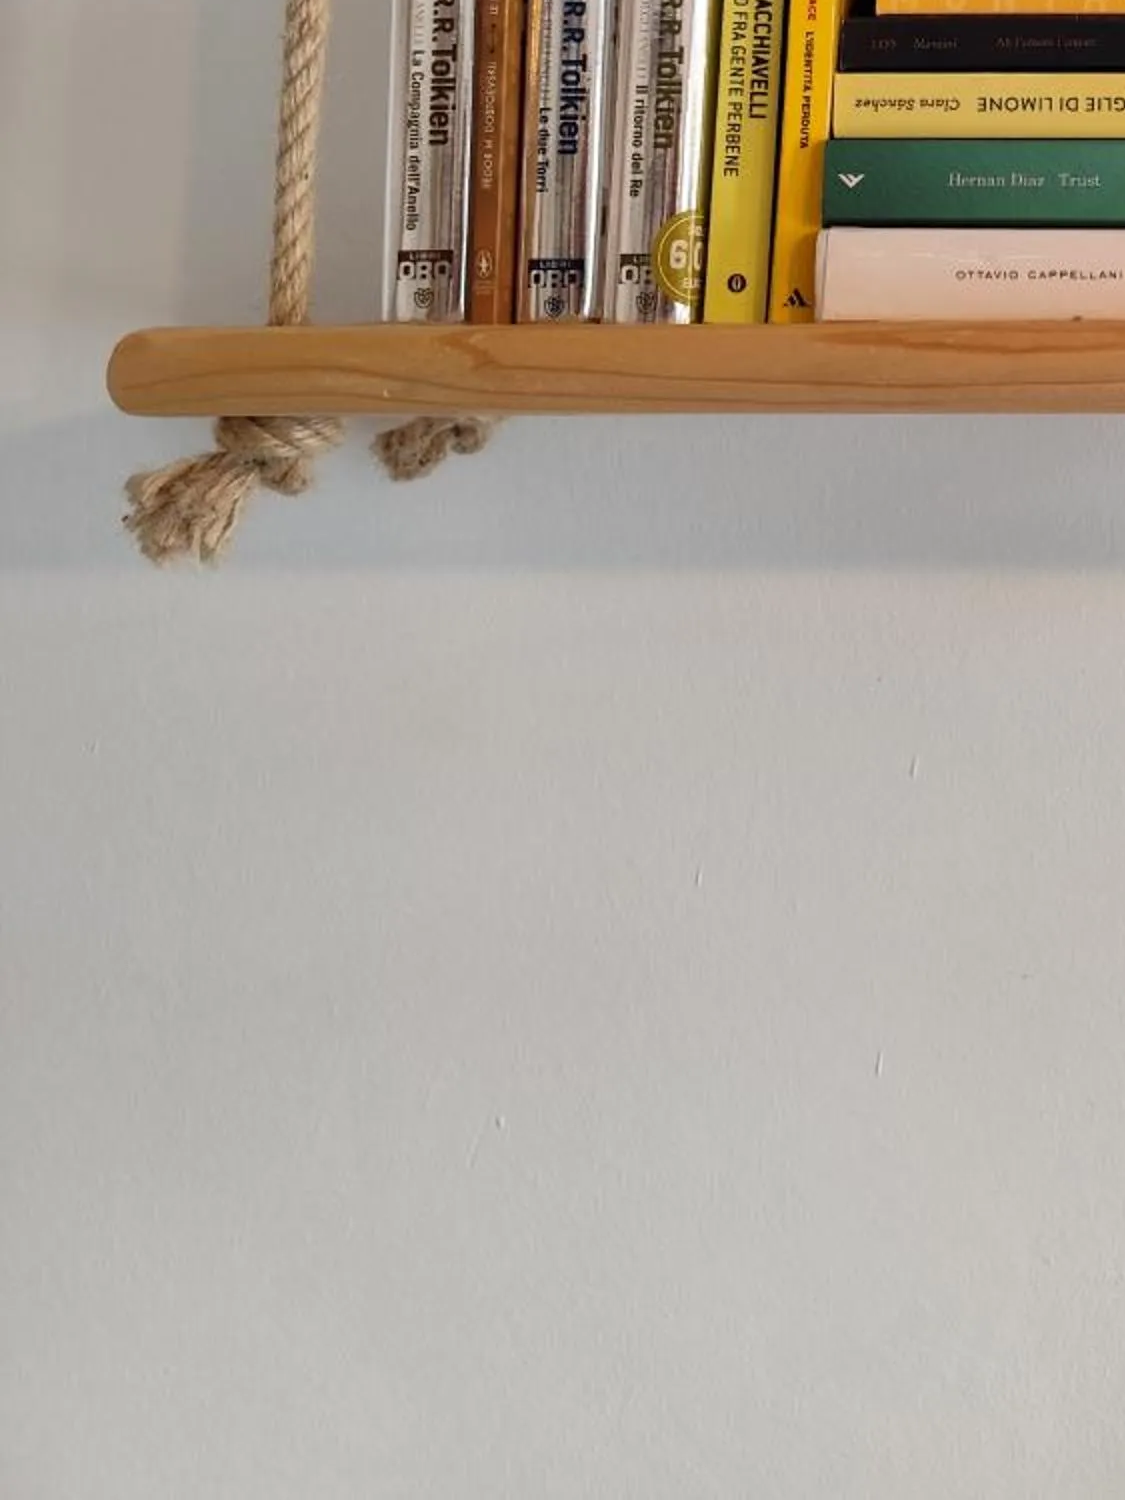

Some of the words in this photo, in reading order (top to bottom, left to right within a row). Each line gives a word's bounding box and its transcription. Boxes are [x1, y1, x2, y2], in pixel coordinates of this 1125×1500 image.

[731, 11, 747, 41] FRA
[411, 49, 426, 67] La
[728, 46, 745, 97] GENTE
[428, 44, 457, 147] Tolkien
[557, 53, 588, 156] Tolkien
[653, 46, 685, 149] Tolkien
[854, 97, 917, 113] Sánchez
[919, 98, 961, 112] Clara
[976, 96, 1054, 113] LIMONE
[1057, 96, 1077, 113] DI
[407, 71, 424, 150] Compagnia
[539, 107, 552, 119] Le
[632, 98, 647, 148] ritorno
[799, 95, 812, 149] PERDUTA
[537, 126, 550, 155] due
[723, 102, 742, 177] PERBENE
[535, 159, 549, 194] Torri
[631, 152, 646, 175] del
[629, 179, 643, 197] Re
[947, 171, 1005, 187] Hernan
[1010, 172, 1045, 187] Diaz
[1057, 172, 1101, 187] Trust
[405, 155, 420, 232] dell'Anello
[621, 265, 658, 284] OR
[955, 269, 1020, 281] OTTAVIO
[1027, 269, 1123, 281] CAPPELLANI
